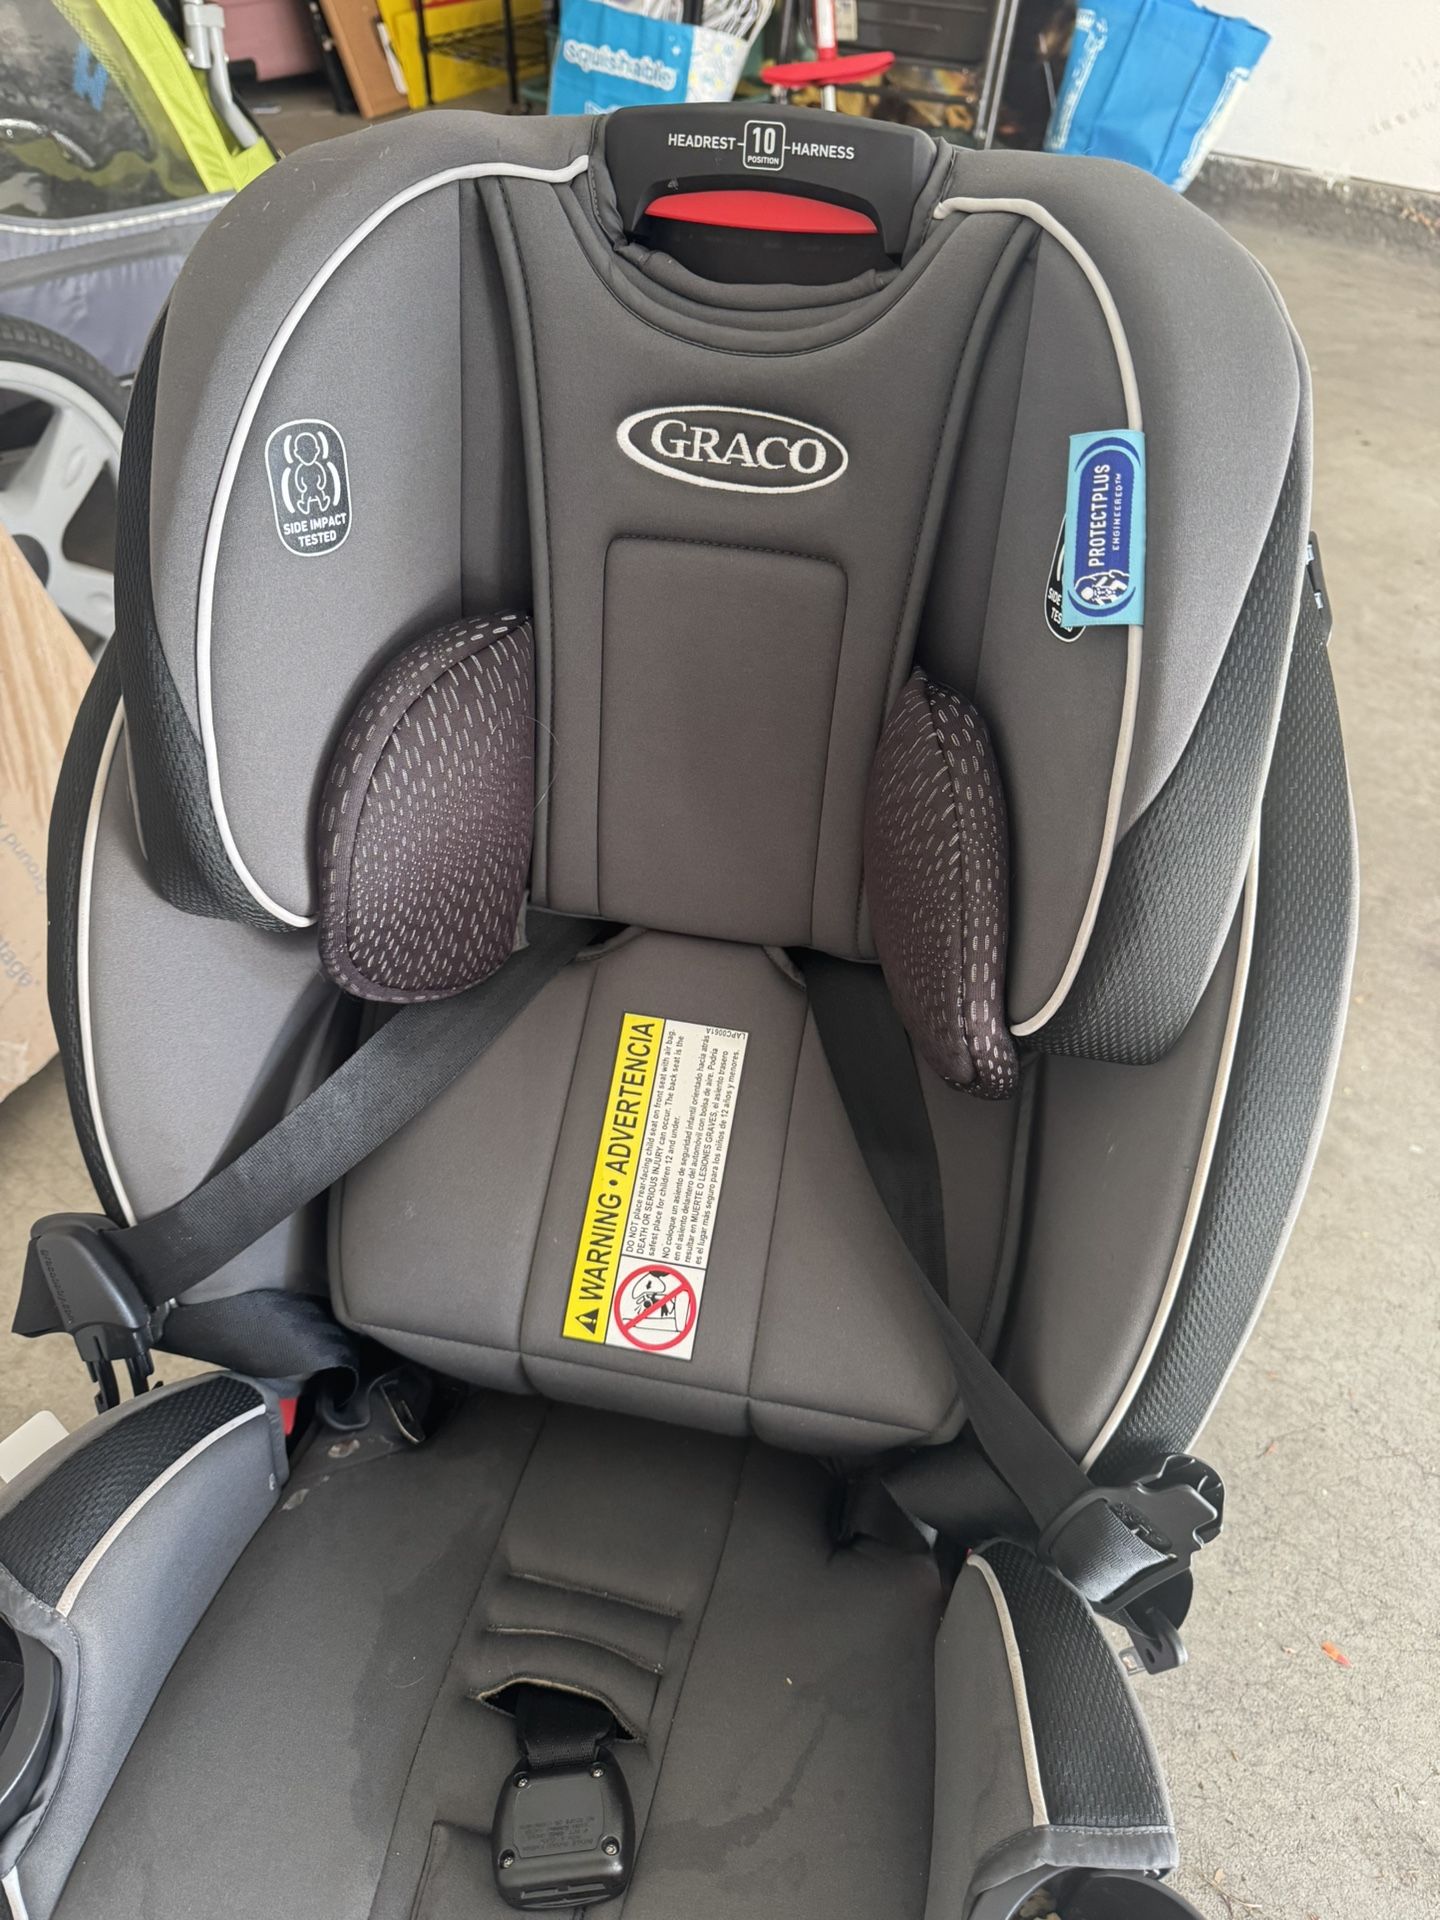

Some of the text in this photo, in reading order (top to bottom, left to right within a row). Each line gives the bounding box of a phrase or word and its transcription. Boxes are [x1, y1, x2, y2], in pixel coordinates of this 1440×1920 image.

[668, 127, 855, 160] HEADREST 10 HARNESS
[747, 155, 779, 165] POSITION
[651, 419, 827, 474] GRACO
[283, 512, 347, 535] SIDE IMPACT
[1088, 464, 1110, 567] PROTECTPLUS
[298, 530, 337, 547] TESTED
[675, 1035, 684, 1047] the
[663, 1045, 671, 1055] air
[659, 1056, 669, 1072] with
[670, 1056, 680, 1071] seat
[696, 1052, 706, 1071] hacia
[717, 1050, 728, 1075] trasero
[656, 1073, 666, 1089] seat
[667, 1072, 677, 1090] back
[689, 1072, 702, 1105] orientado
[712, 1075, 723, 1101] asiento
[653, 1089, 663, 1108] front
[664, 1091, 673, 1105] The
[702, 1087, 710, 1096] de
[652, 1109, 659, 1119] on
[698, 1097, 709, 1116] bolsa
[720, 1109, 728, 1117] 12
[685, 1105, 696, 1129] infantil
[697, 1117, 705, 1131] con
[718, 1119, 726, 1129] de
[647, 1119, 657, 1136] seat
[658, 1131, 666, 1144] can
[643, 1137, 654, 1156] child
[666, 1139, 675, 1154] and
[678, 1130, 693, 1166] seguridad
[579, 1023, 654, 1300] WARNING ADVERTENCIA
[651, 1145, 663, 1174] INJURY
[664, 1155, 672, 1163] 12
[698, 1144, 711, 1181] LESIONES
[711, 1152, 720, 1164] los
[635, 1156, 652, 1197] rear-facing
[676, 1166, 685, 1175] de
[687, 1167, 696, 1178] del
[709, 1165, 720, 1182] para
[658, 1165, 670, 1196] children
[644, 1176, 657, 1211] SERIOUS
[671, 1177, 683, 1203] asiento
[680, 1179, 693, 1214] delantero
[705, 1183, 717, 1209] seguro
[631, 1198, 644, 1219] place
[655, 1197, 664, 1208] for
[670, 1204, 678, 1214] un
[690, 1190, 703, 1222] MUERTE
[641, 1213, 650, 1225] OR
[651, 1210, 664, 1231] place
[628, 1221, 638, 1238] NOT
[663, 1215, 678, 1245] coloque
[675, 1214, 687, 1242] asiento
[689, 1224, 697, 1233] en
[697, 1226, 709, 1246] lugar
[625, 1239, 635, 1252] DO
[636, 1226, 648, 1254] DEATH
[647, 1232, 658, 1256] safest
[674, 1242, 682, 1250] el
[683, 1234, 695, 1262] resultar
[661, 1246, 670, 1258] NO
[673, 1251, 681, 1260] en
[695, 1246, 704, 1254] el
[695, 1255, 702, 1264] es
